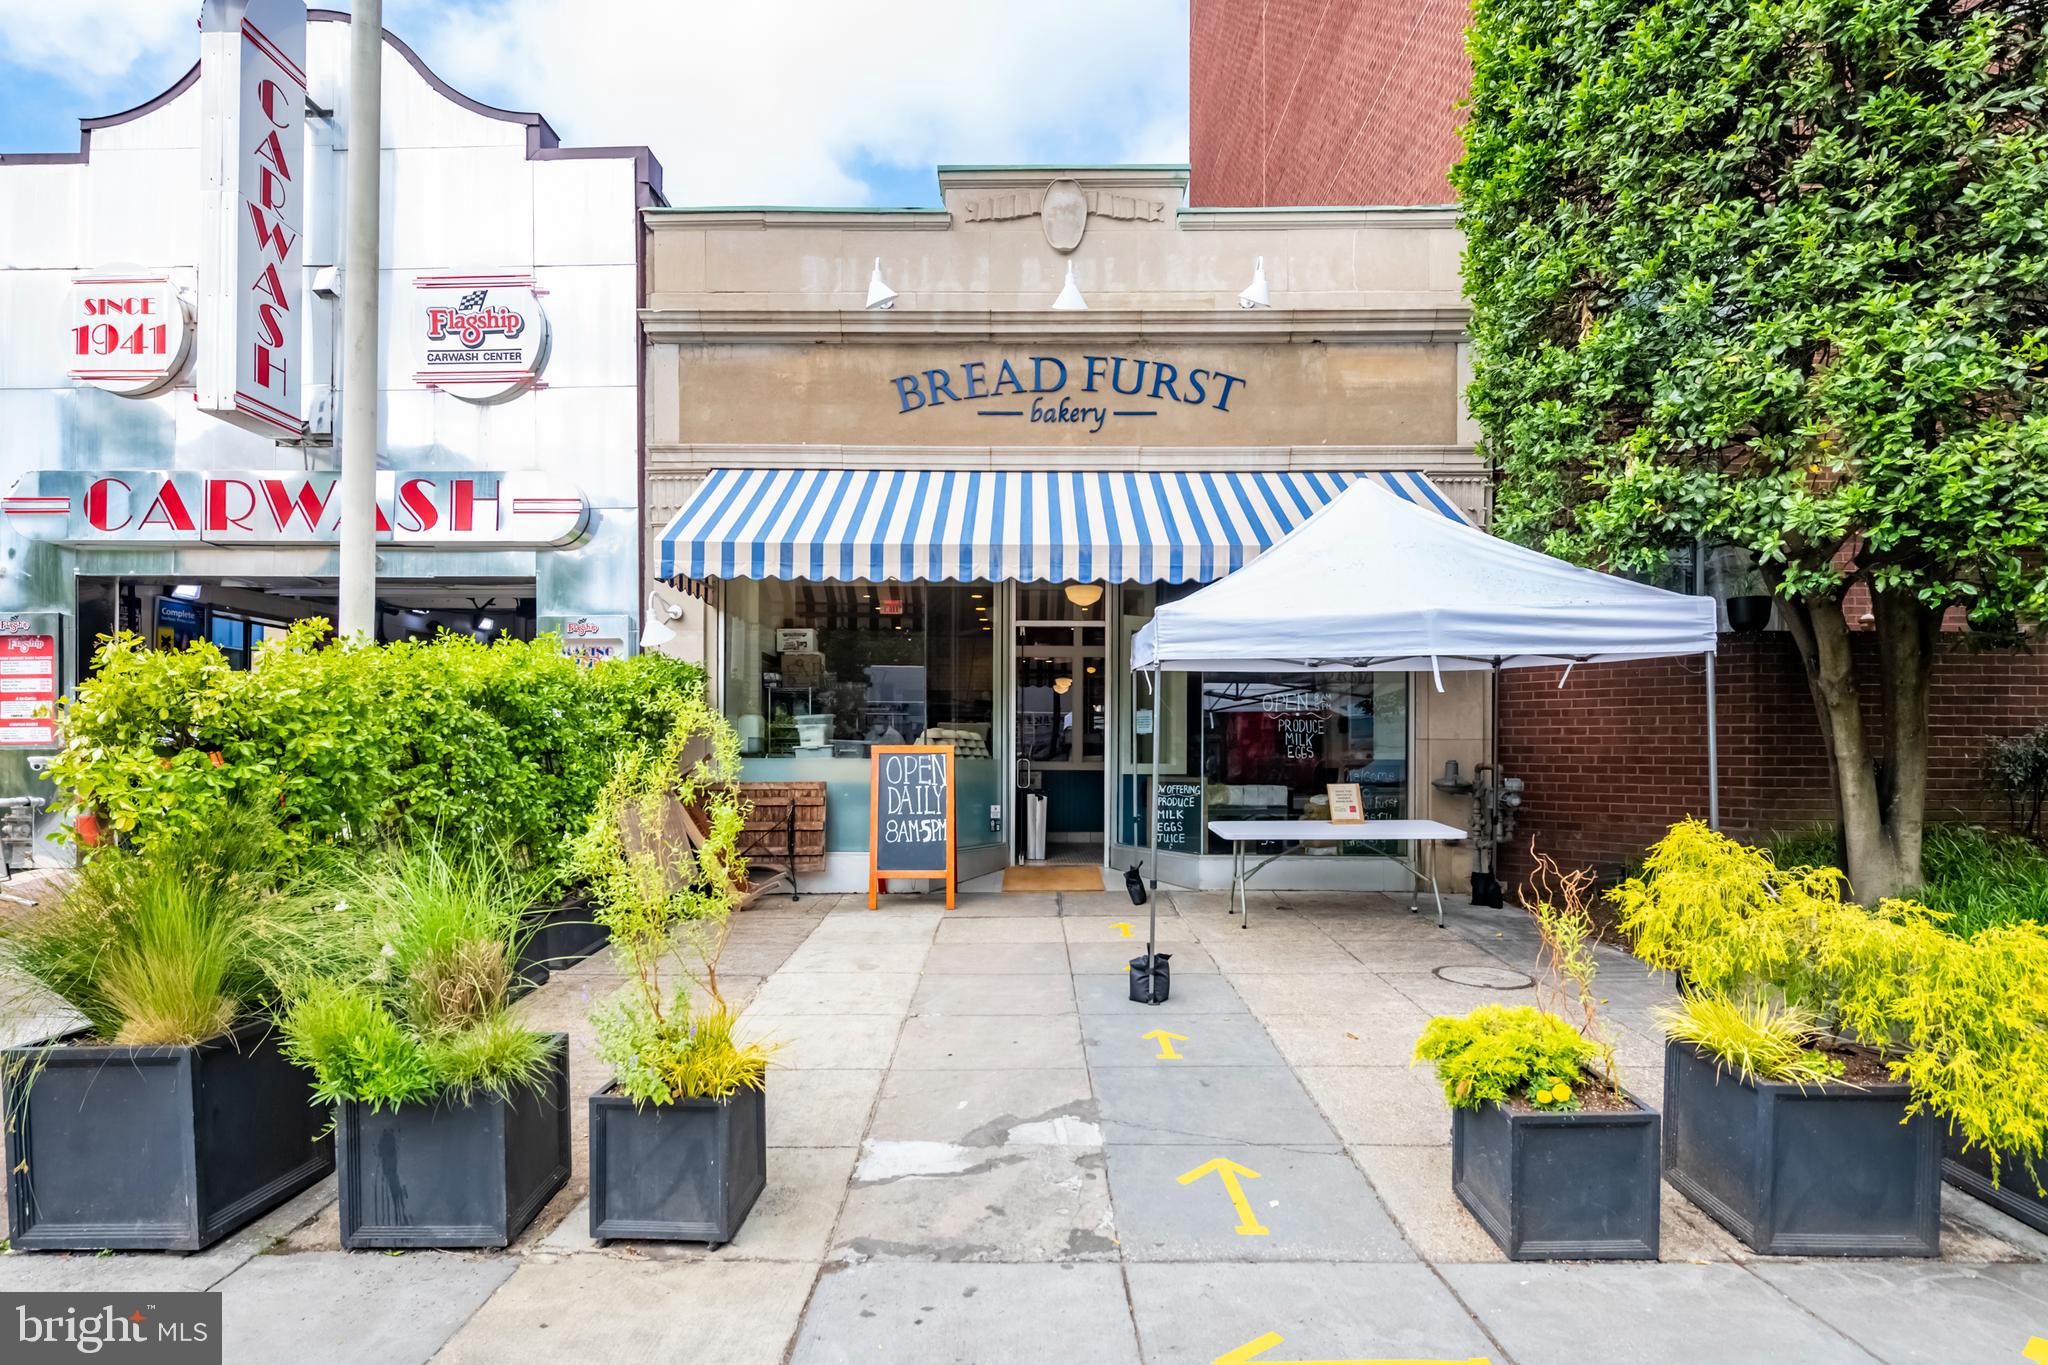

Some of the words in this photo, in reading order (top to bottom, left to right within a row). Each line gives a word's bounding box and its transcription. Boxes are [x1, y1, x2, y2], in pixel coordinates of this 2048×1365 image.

[245, 79, 296, 397] CARWASH
[83, 297, 157, 316] SINCE
[427, 306, 524, 347] Flagship
[71, 322, 166, 356] 1941
[426, 352, 479, 362] CARWASH
[483, 351, 522, 361] CENTER
[889, 356, 1067, 414] BREAD
[1081, 355, 1247, 413] FURST
[1029, 397, 1107, 434] bakery
[161, 606, 196, 620] Complete
[1262, 692, 1309, 712] OPEN
[1278, 718, 1326, 735] PRODUCE
[1285, 732, 1315, 747] MILK
[1287, 744, 1314, 759] EGGS
[886, 754, 947, 786] OPEN
[1166, 784, 1201, 795] OFFERING
[887, 785, 947, 815] DAILY
[1157, 797, 1195, 808] PRODUCE
[1157, 809, 1185, 820] MILK
[885, 819, 947, 843] 8AM-5PM
[1157, 821, 1184, 832] EGGS
[1156, 833, 1186, 843] JUICE
